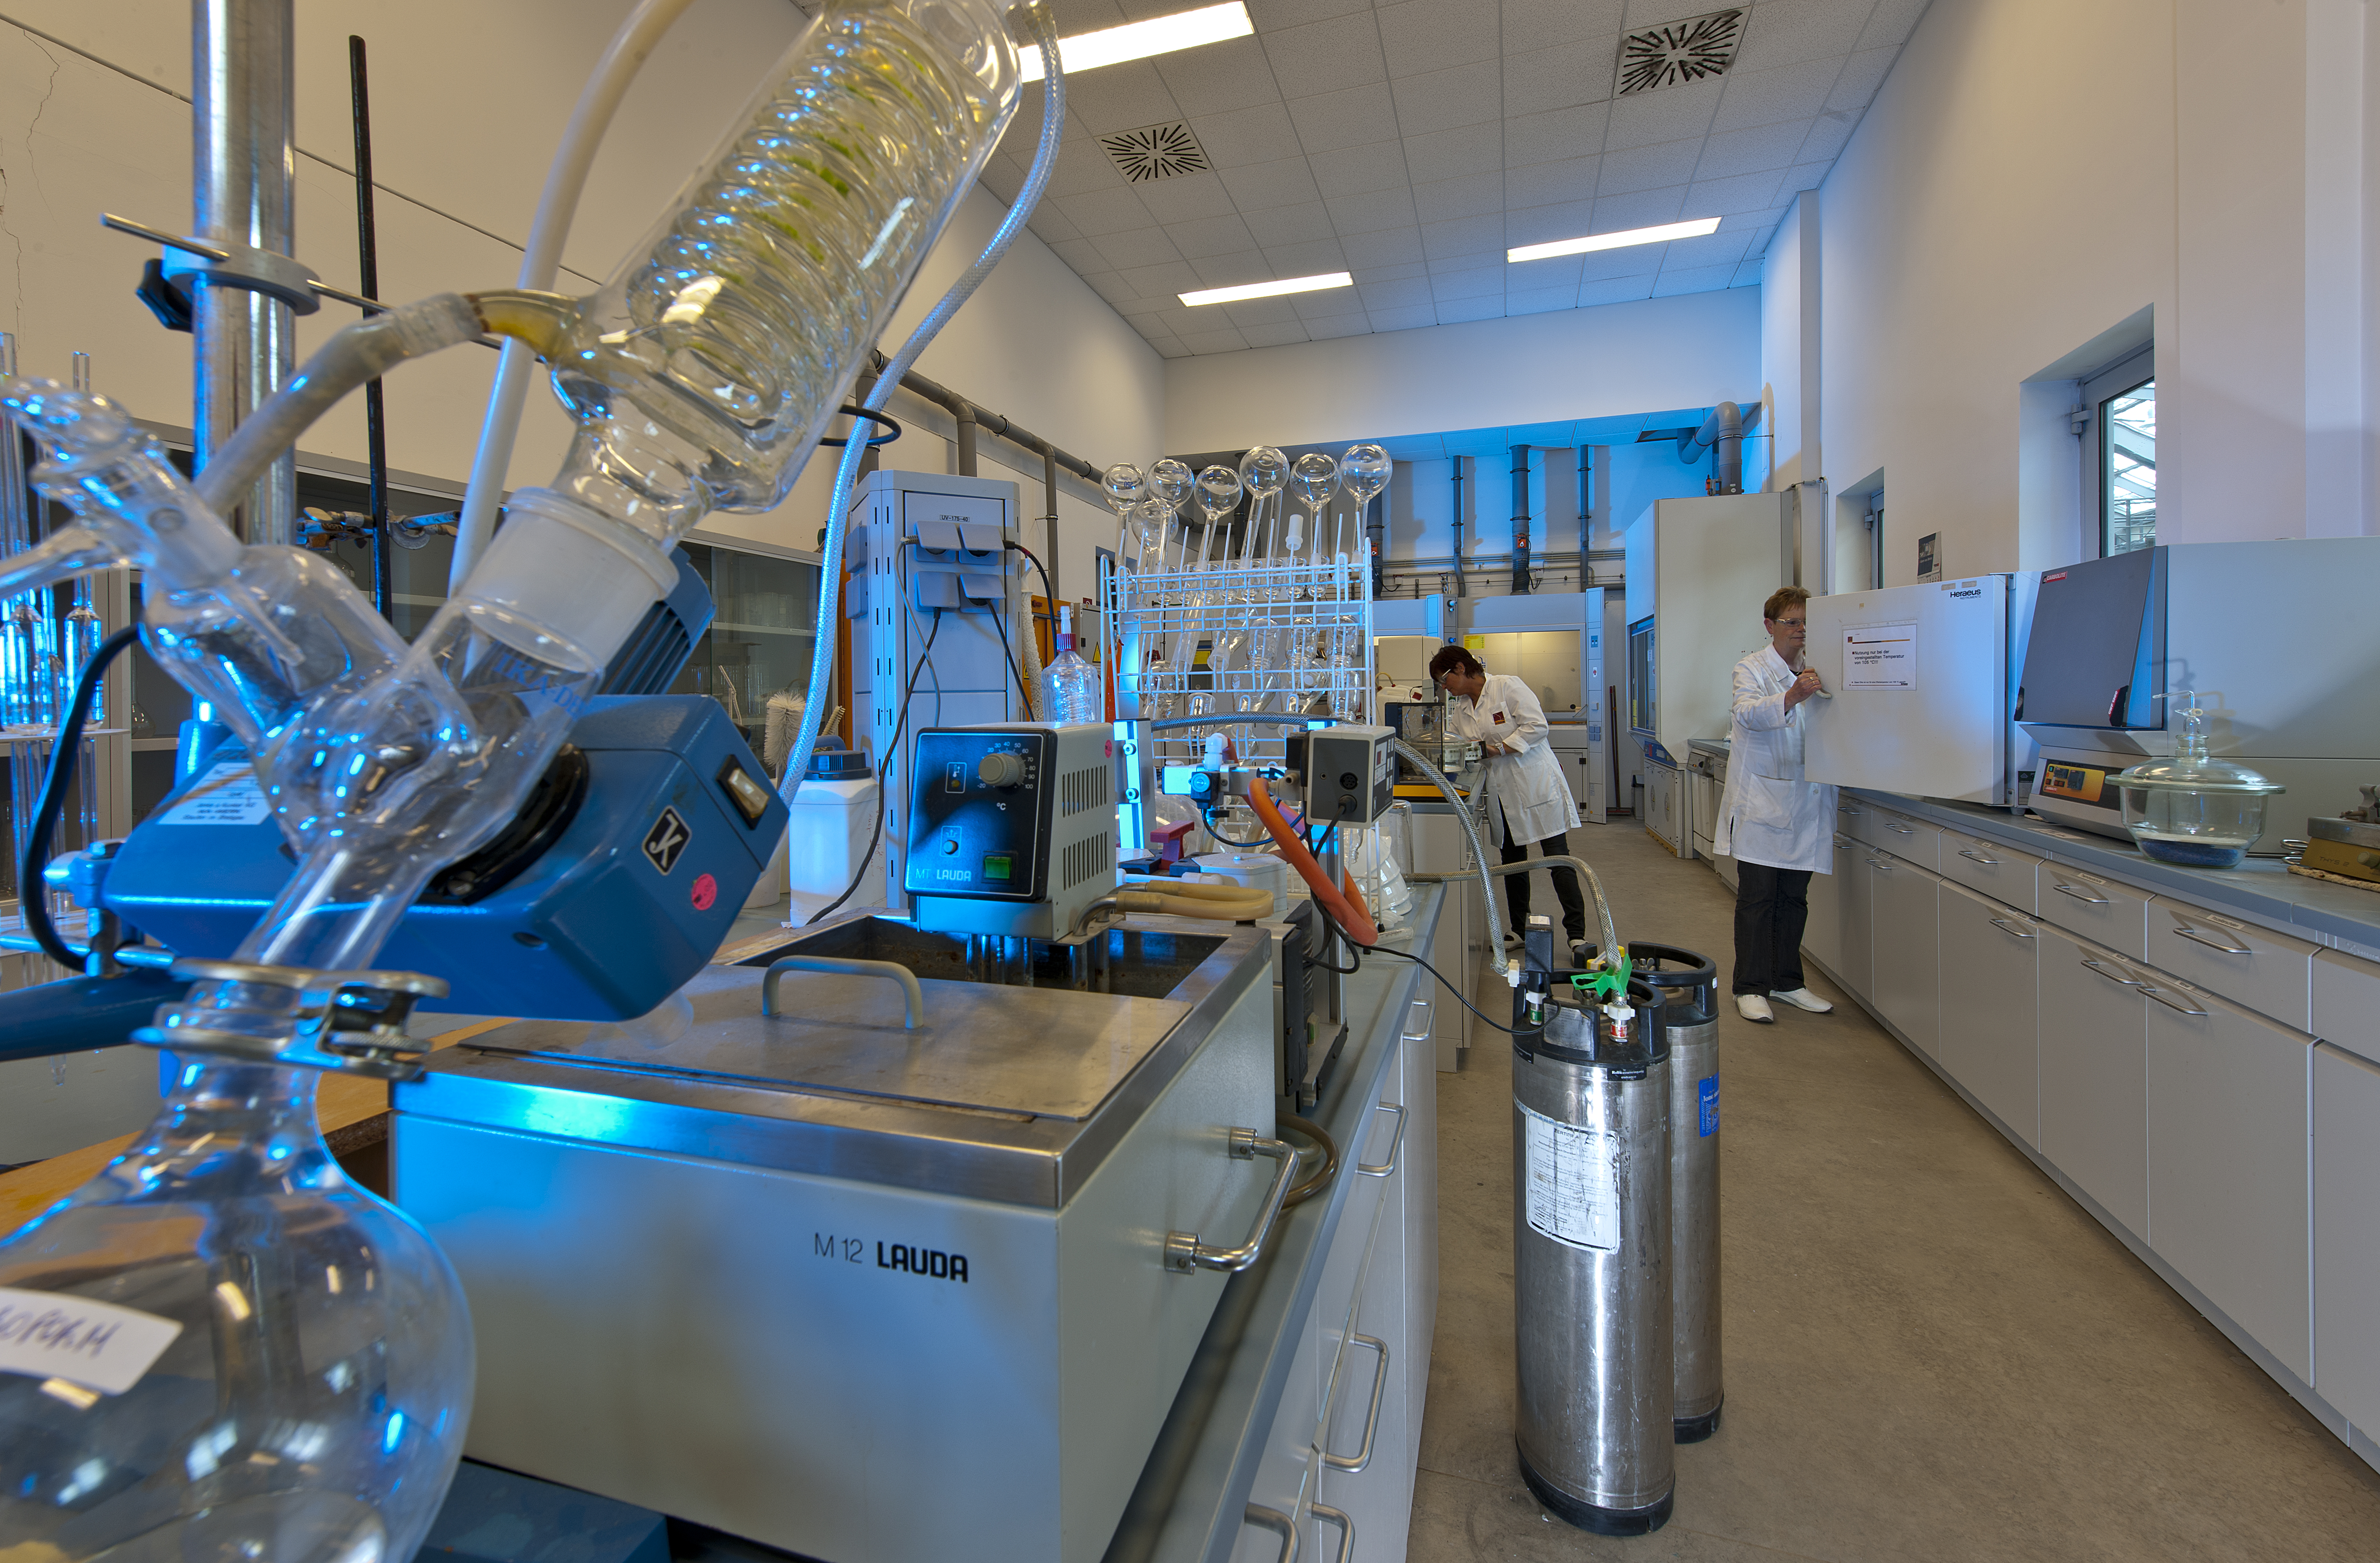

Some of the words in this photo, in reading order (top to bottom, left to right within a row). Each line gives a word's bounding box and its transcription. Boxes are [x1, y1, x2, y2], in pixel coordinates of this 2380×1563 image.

[1950, 589, 1981, 598] Heraeus
[2319, 856, 2340, 865] THYS
[936, 869, 972, 882] LAUDA
[814, 1232, 834, 1258] M
[841, 1238, 863, 1264] 12
[877, 1240, 968, 1284] LAUDA
